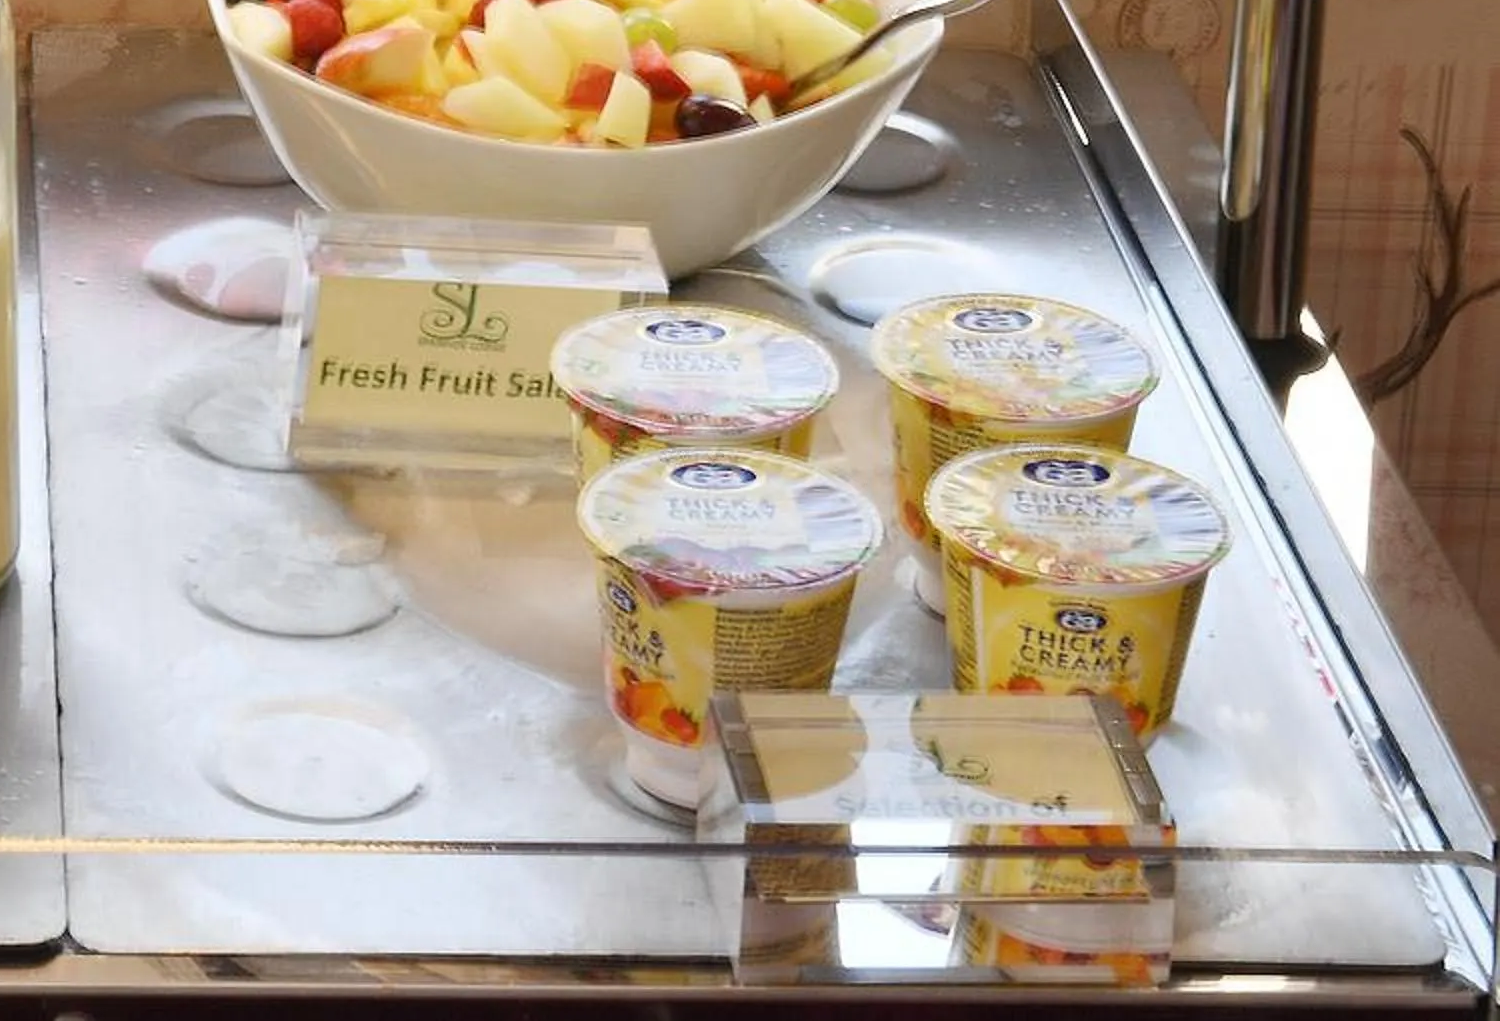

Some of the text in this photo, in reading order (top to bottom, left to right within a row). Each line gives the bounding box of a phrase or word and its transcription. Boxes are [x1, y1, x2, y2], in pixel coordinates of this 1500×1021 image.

[320, 361, 568, 401] Fresh Fruit Sal
[1018, 624, 1106, 654] THICK
[1019, 644, 1131, 672] CREAMY
